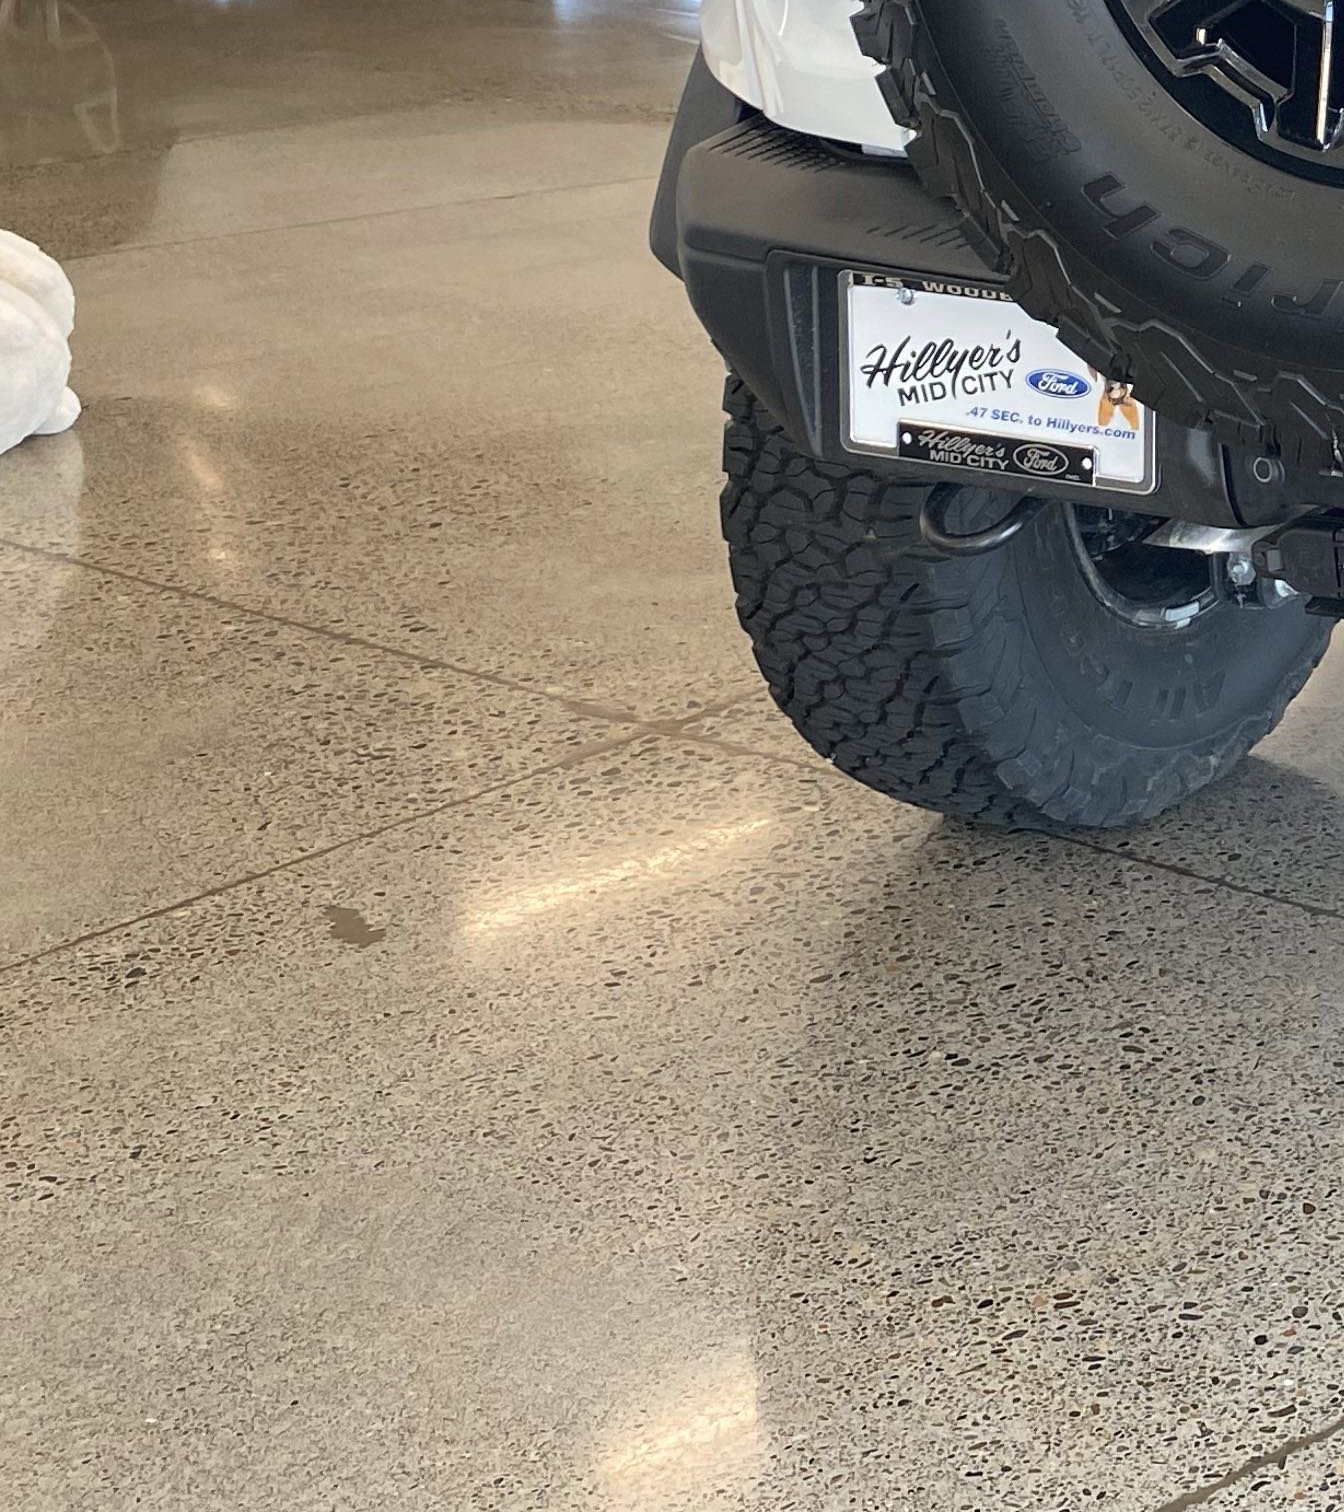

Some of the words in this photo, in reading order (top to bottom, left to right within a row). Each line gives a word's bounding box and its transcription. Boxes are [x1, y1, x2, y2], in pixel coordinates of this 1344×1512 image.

[861, 273, 904, 288] I-5
[860, 329, 1022, 399] Hillyer's
[897, 381, 947, 406] MID
[961, 369, 1014, 395] CITY
[1037, 370, 1079, 396] Ford
[991, 408, 1024, 423] SEC.
[1027, 414, 1042, 427] to
[1046, 417, 1137, 439] Hillyers.com
[917, 428, 1006, 457] Hillyer's
[929, 449, 962, 464] MID
[966, 454, 1010, 471] CITY
[1022, 447, 1059, 471] Ford
